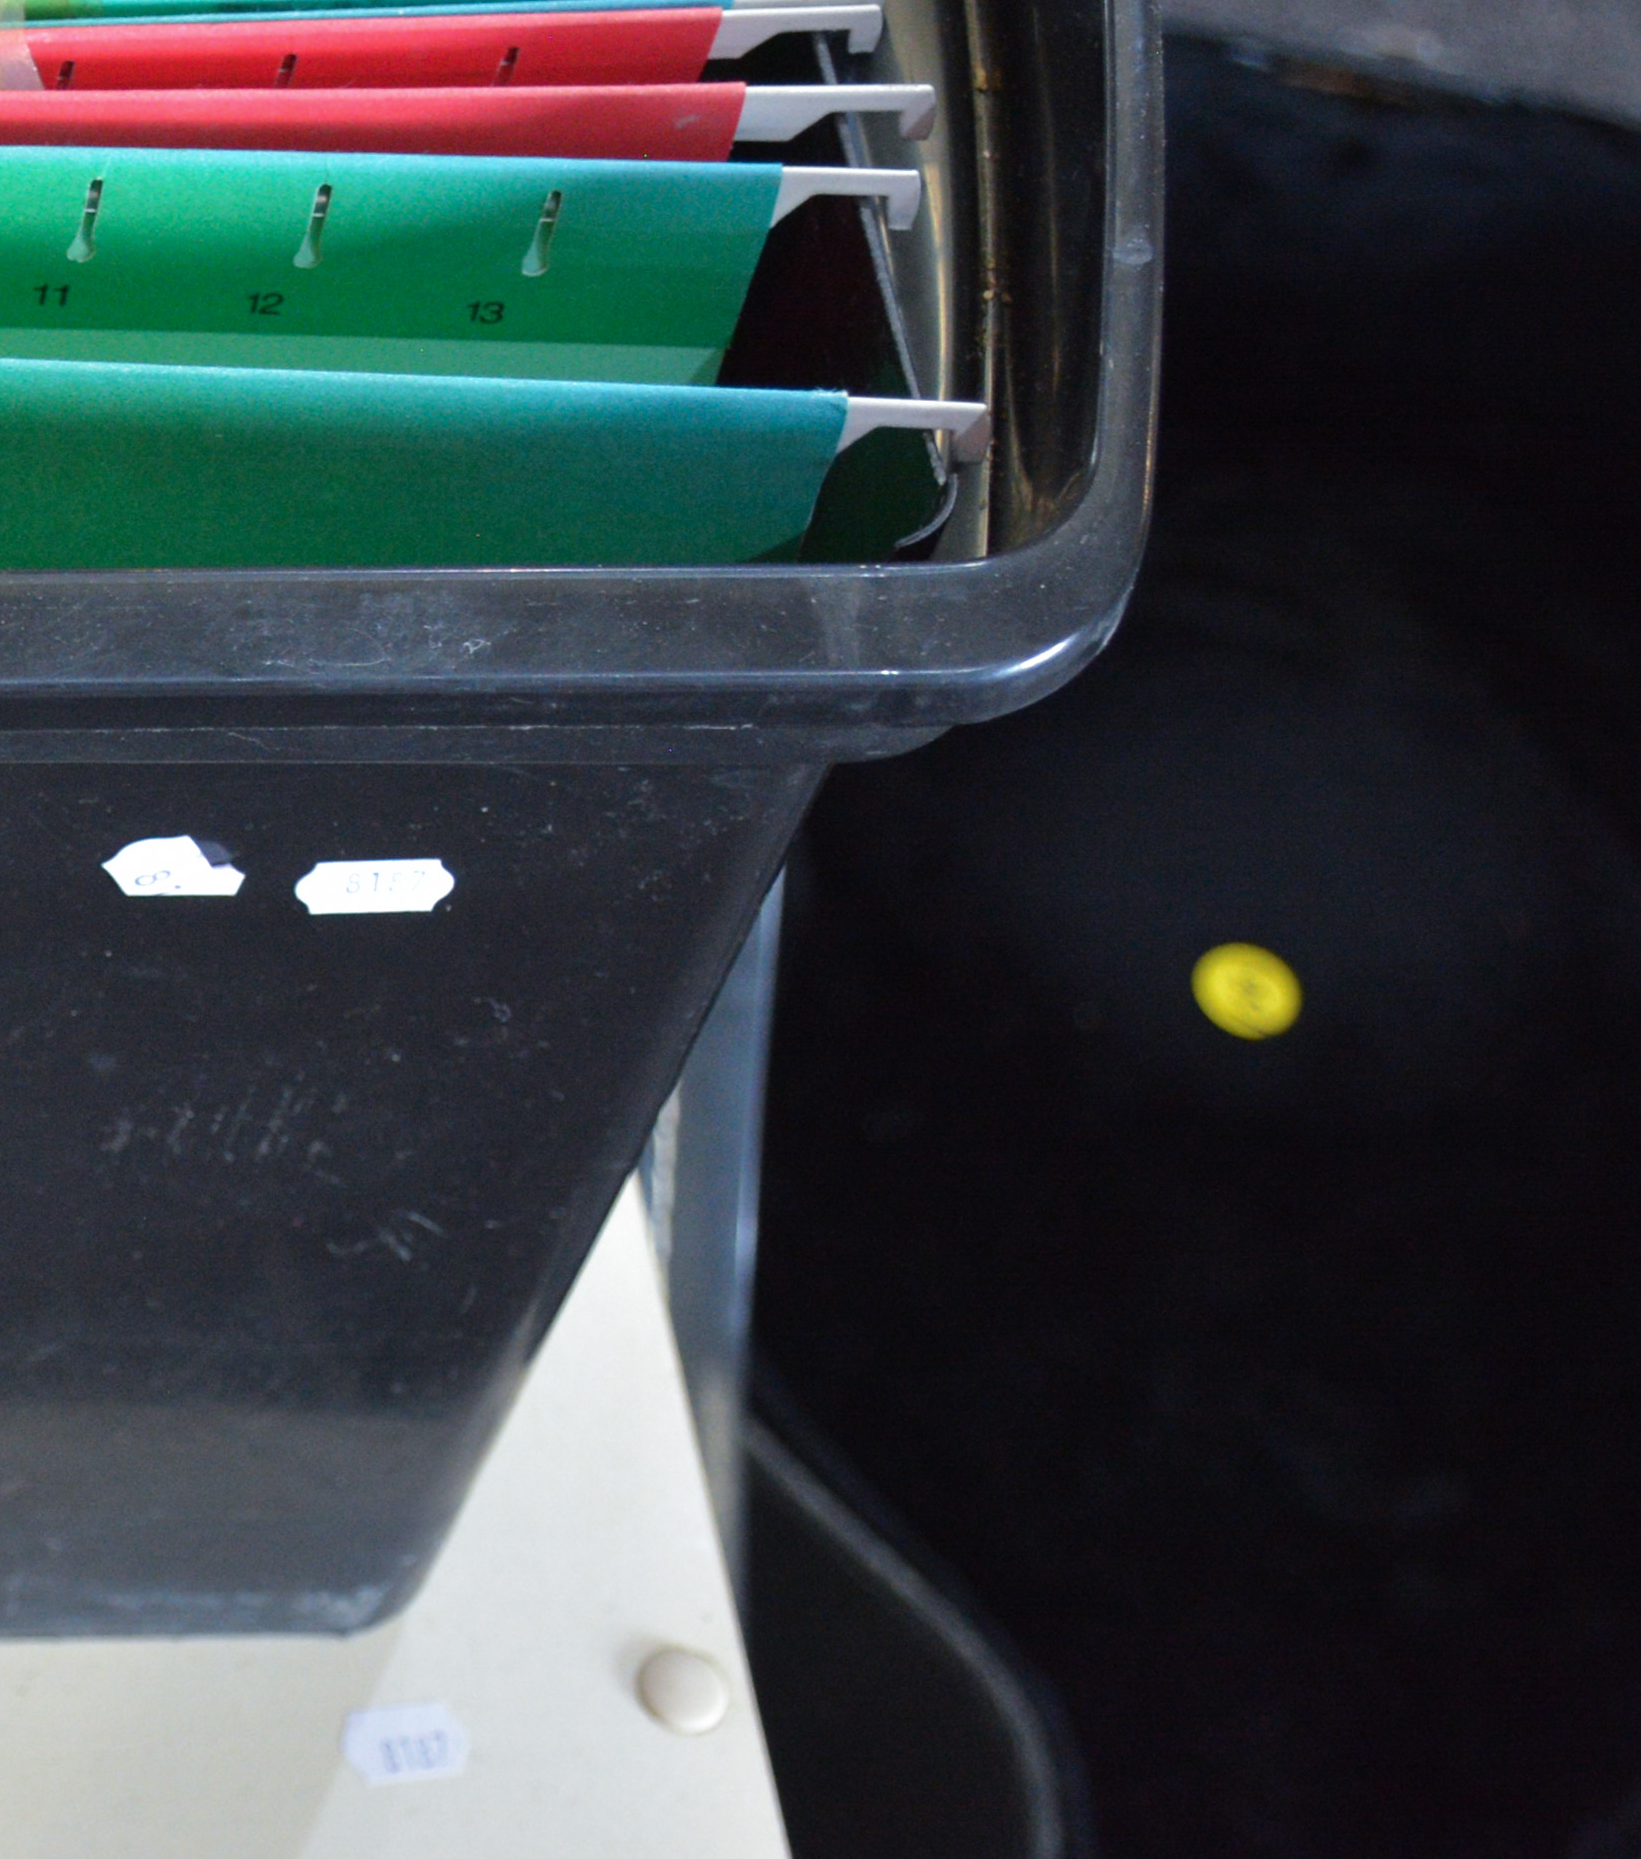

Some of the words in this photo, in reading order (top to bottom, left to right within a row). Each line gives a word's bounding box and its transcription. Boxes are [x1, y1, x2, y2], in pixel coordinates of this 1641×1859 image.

[34, 284, 70, 306] 11
[249, 293, 285, 315] 12
[468, 302, 505, 324] 13
